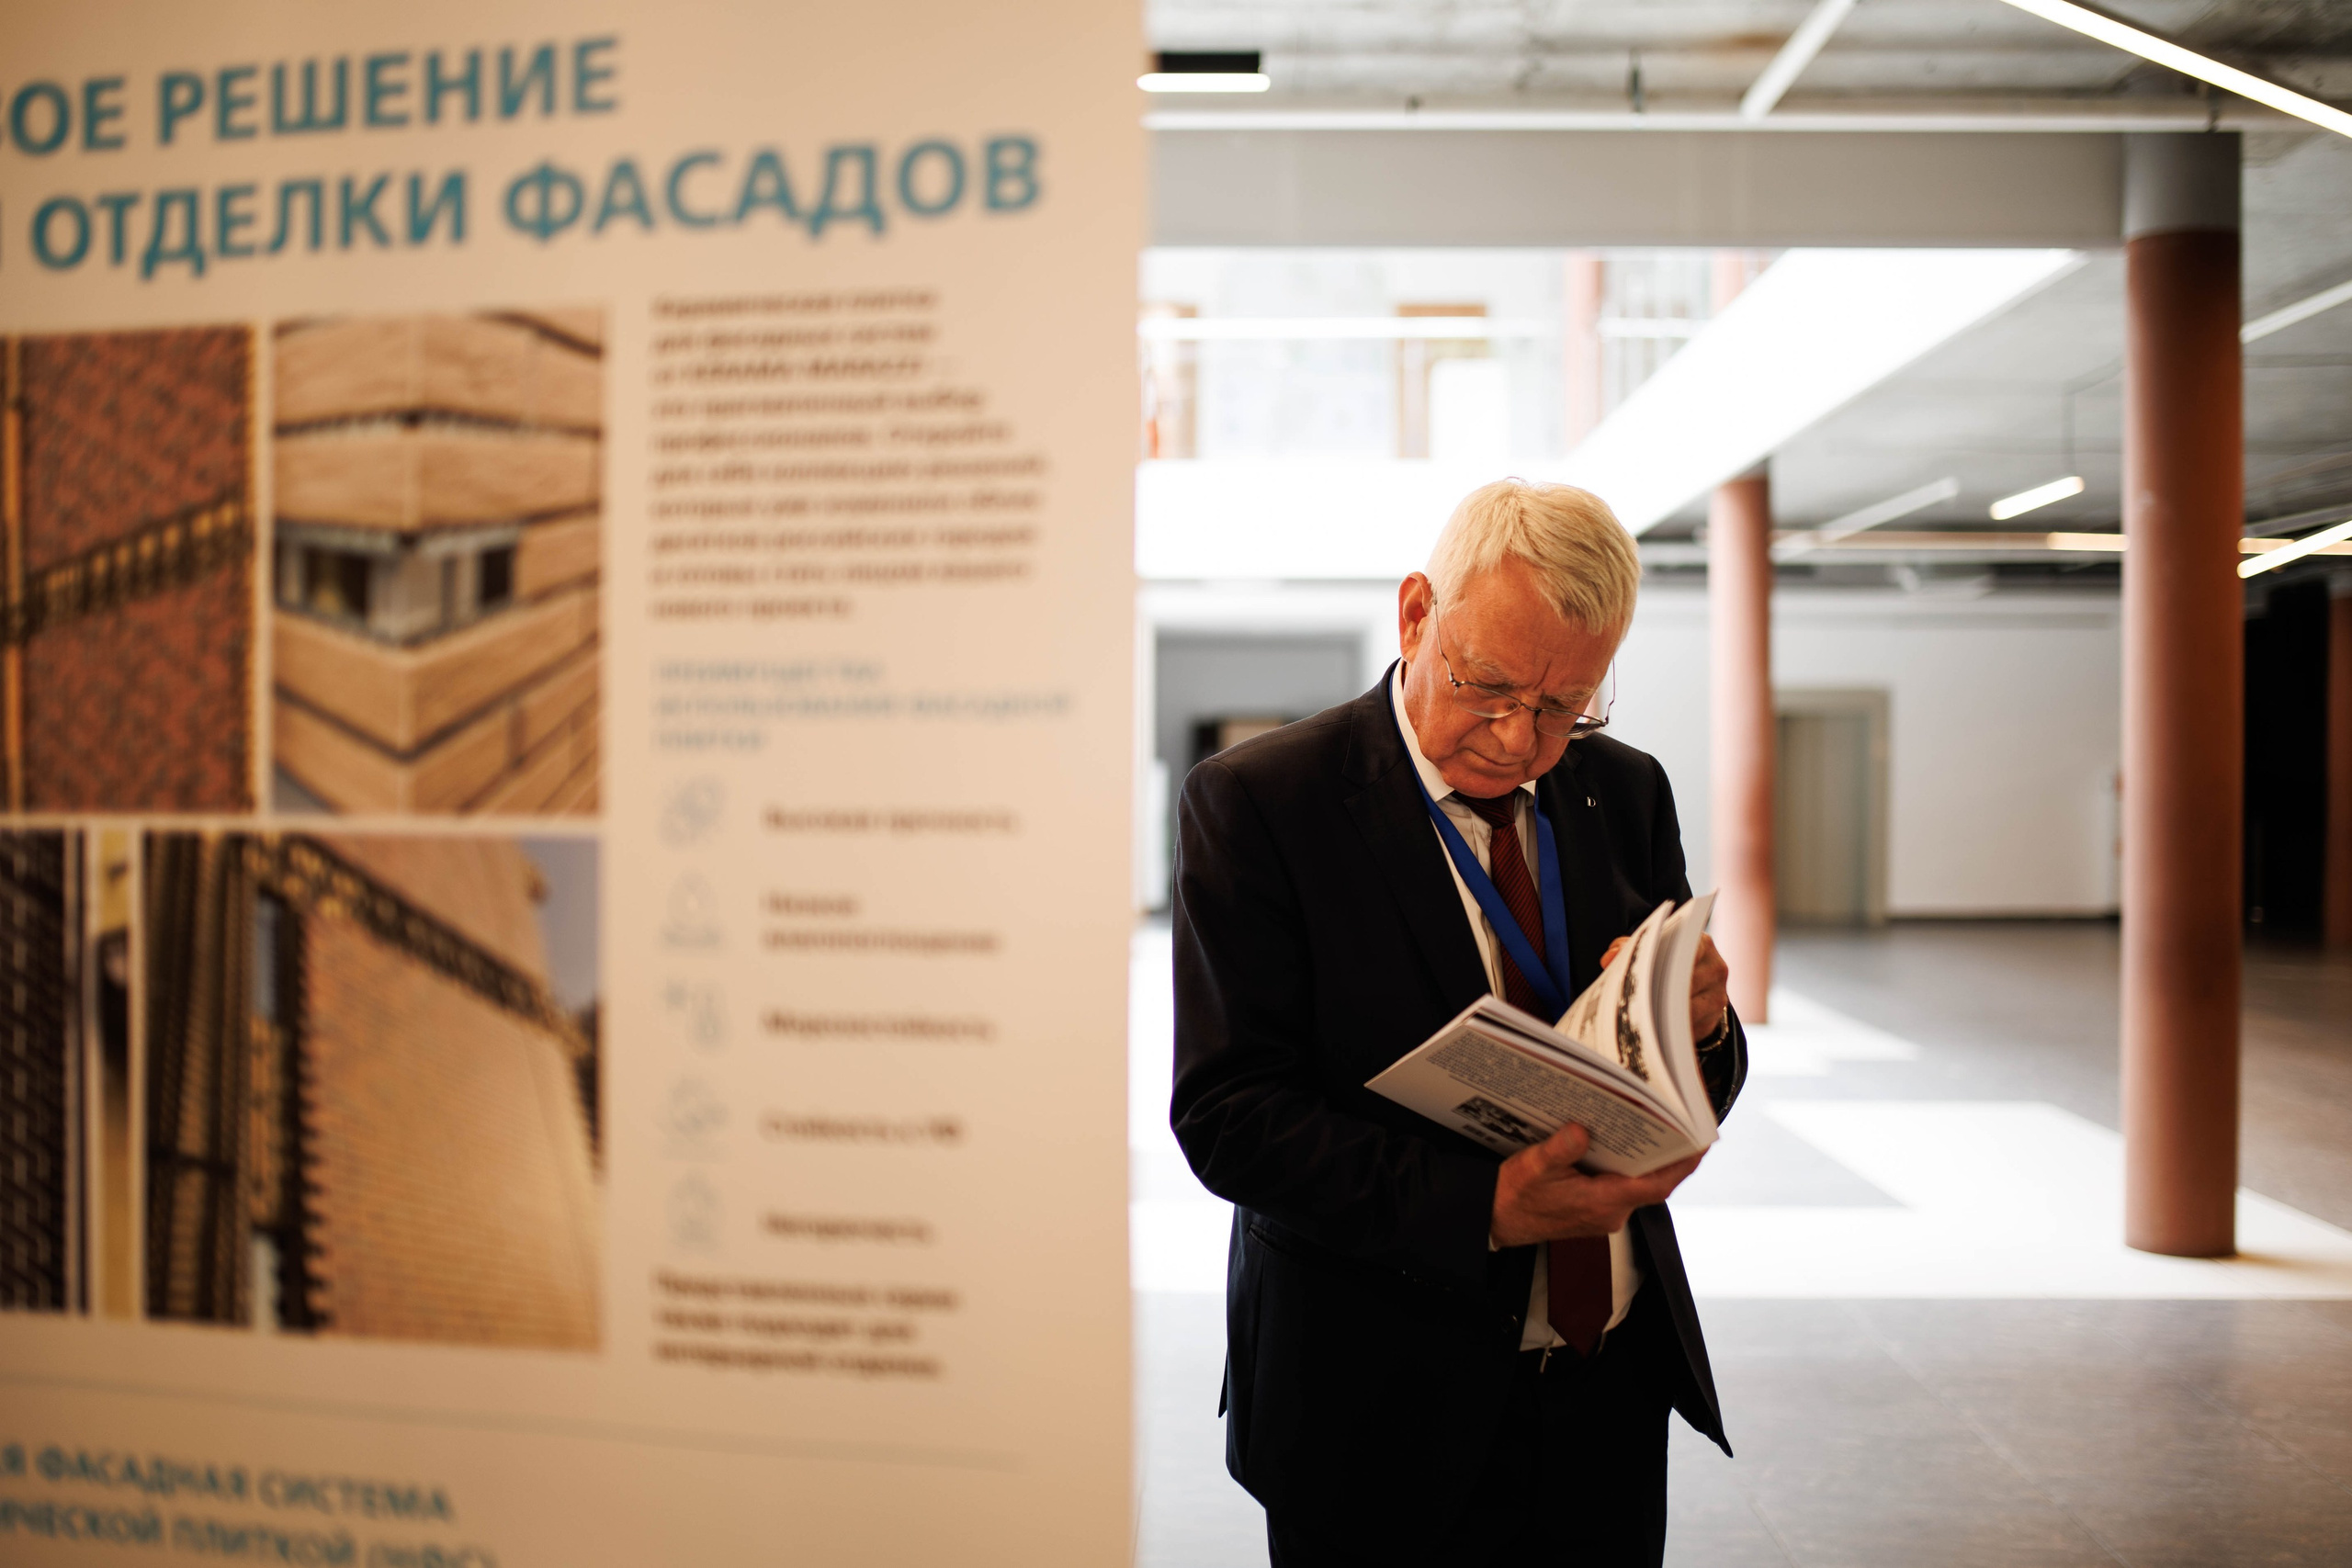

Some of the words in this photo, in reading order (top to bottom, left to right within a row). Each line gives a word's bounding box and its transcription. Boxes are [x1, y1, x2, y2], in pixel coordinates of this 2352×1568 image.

[0, 76, 128, 157] ОЕ
[158, 37, 620, 147] РЕШЕНИЕ
[31, 171, 469, 281] ОТДЕЛКИ
[502, 136, 1044, 243] ФАСАДОВ
[35, 1442, 251, 1505] ФАСАДНАЯ
[260, 1467, 457, 1525] СИСТЕМА
